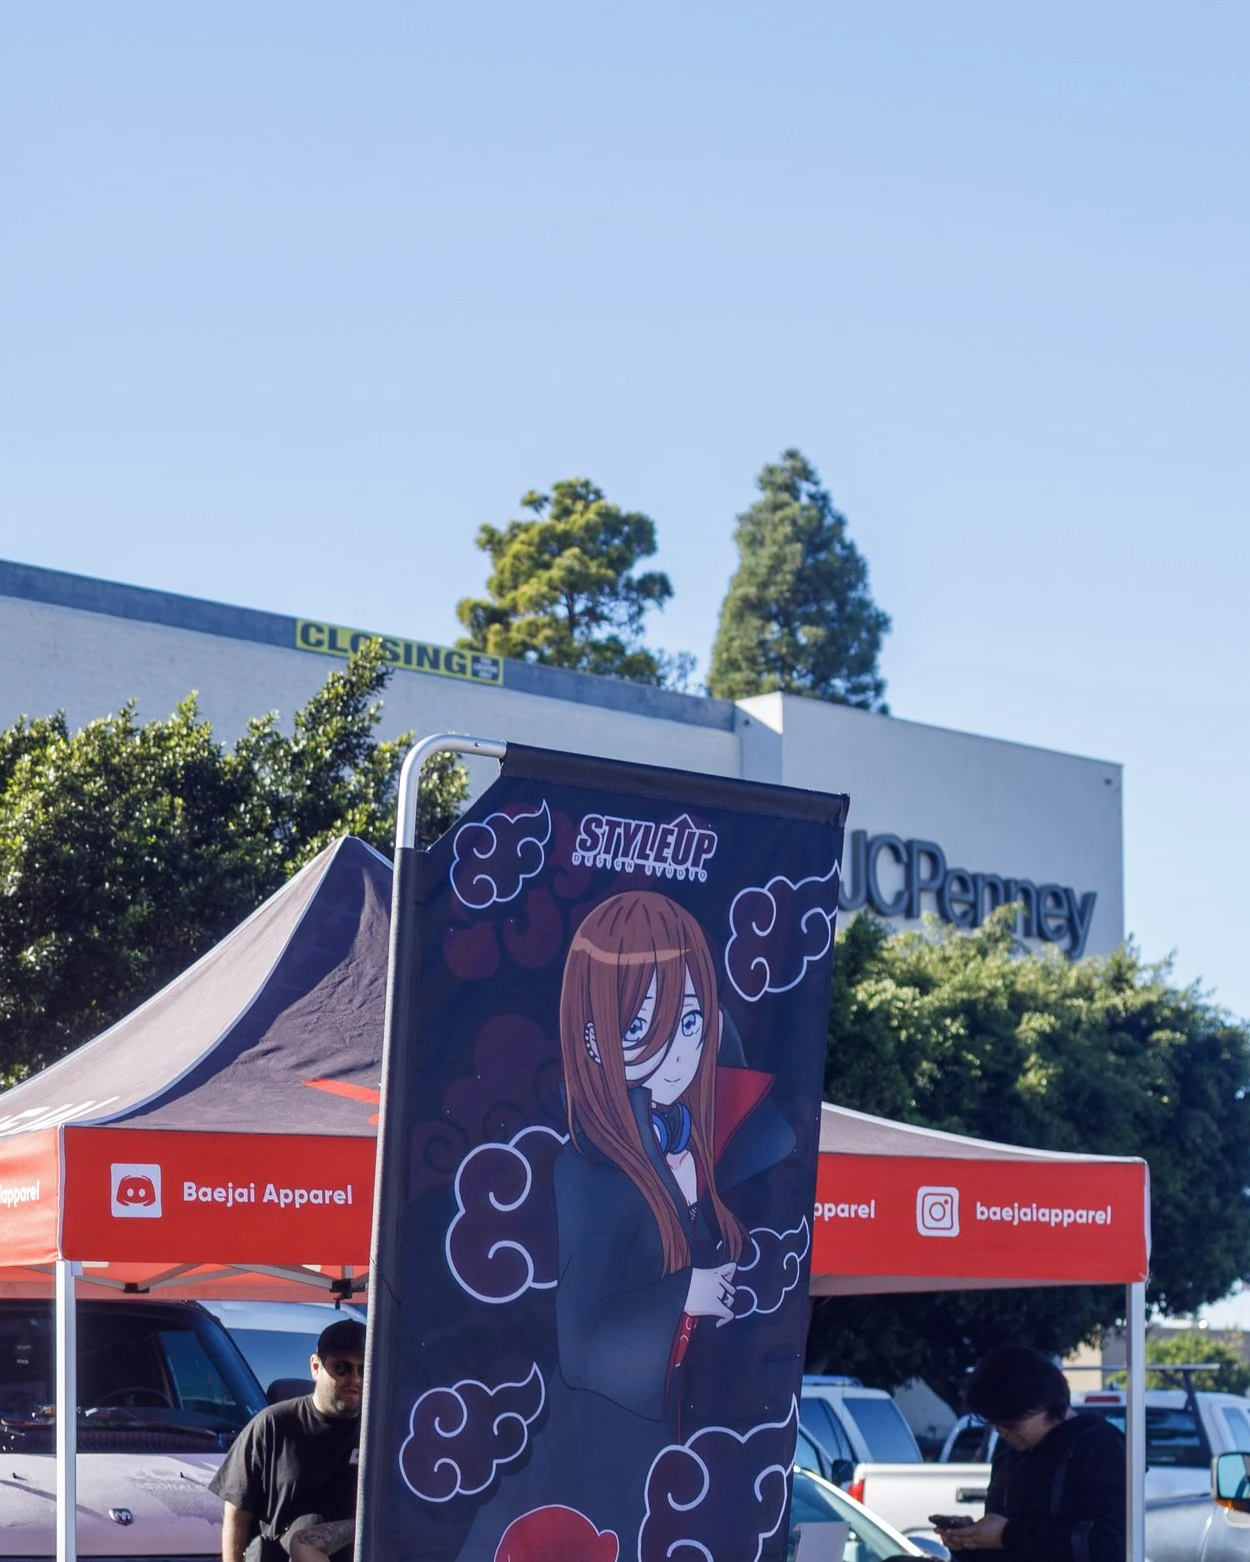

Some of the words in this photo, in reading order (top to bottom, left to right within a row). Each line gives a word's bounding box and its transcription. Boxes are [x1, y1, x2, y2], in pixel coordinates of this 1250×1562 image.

[300, 622, 468, 677] CLOSING
[576, 813, 718, 873] STYLEUP
[572, 851, 635, 873] DESIGN
[644, 864, 708, 882] STUDIO
[838, 829, 1097, 963] JCPenney
[182, 1181, 255, 1208] Baejai
[262, 1182, 353, 1208] Apparel
[976, 1201, 1112, 1227] baejaiapparel
